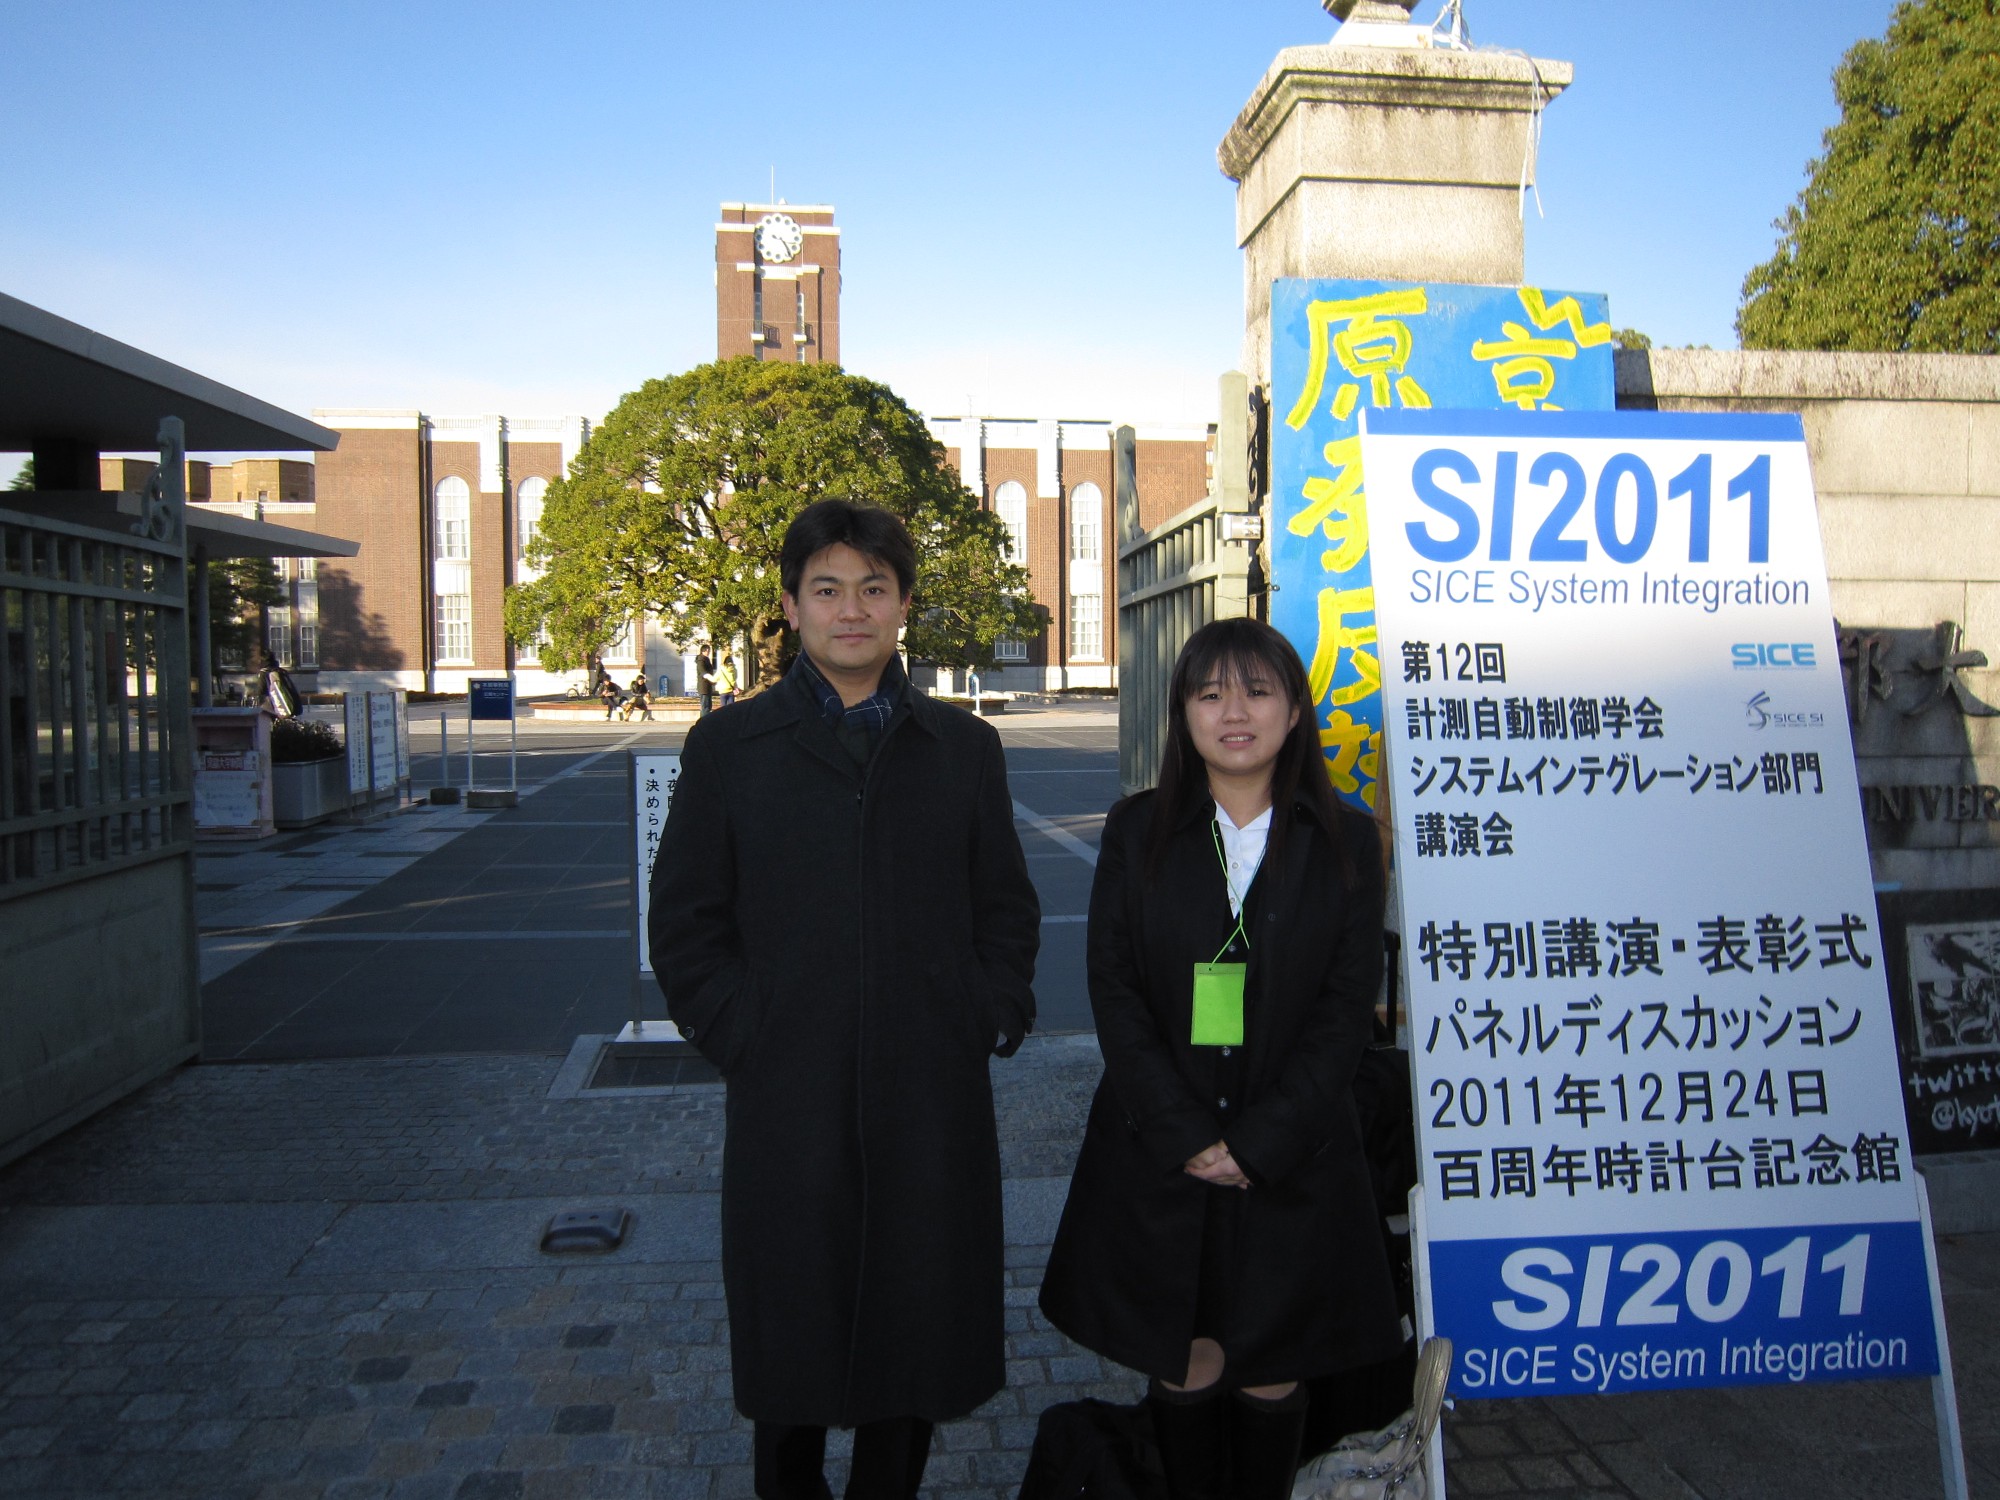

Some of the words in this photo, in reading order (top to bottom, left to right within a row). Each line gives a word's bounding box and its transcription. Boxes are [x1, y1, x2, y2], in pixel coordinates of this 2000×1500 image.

[1405, 448, 1772, 565] SI2011
[1410, 570, 1495, 605] SICE
[1508, 572, 1629, 612] System
[1642, 572, 1810, 613] Integration
[1401, 640, 1507, 685] 第12回
[1731, 643, 1817, 666] SICE
[1405, 695, 1665, 741] 計測自動制御学会
[1773, 713, 1805, 723] SICE
[1809, 712, 1824, 722] SI
[1409, 752, 1824, 798] システムインテグレーション部門
[645, 778, 661, 893] 決められた
[1416, 813, 1514, 858] 講演会
[1418, 913, 1874, 983] 特別講演・表彰式
[1424, 994, 1865, 1058] パネルディスカッション
[1429, 1068, 1829, 1130] 2011年12月24日
[1433, 1132, 1902, 1202] 百周年時計台記念館
[1491, 1233, 1871, 1332] SI2011
[1462, 1344, 1557, 1388] SICE
[1571, 1340, 1707, 1391] System
[1720, 1331, 1907, 1384] Integration
